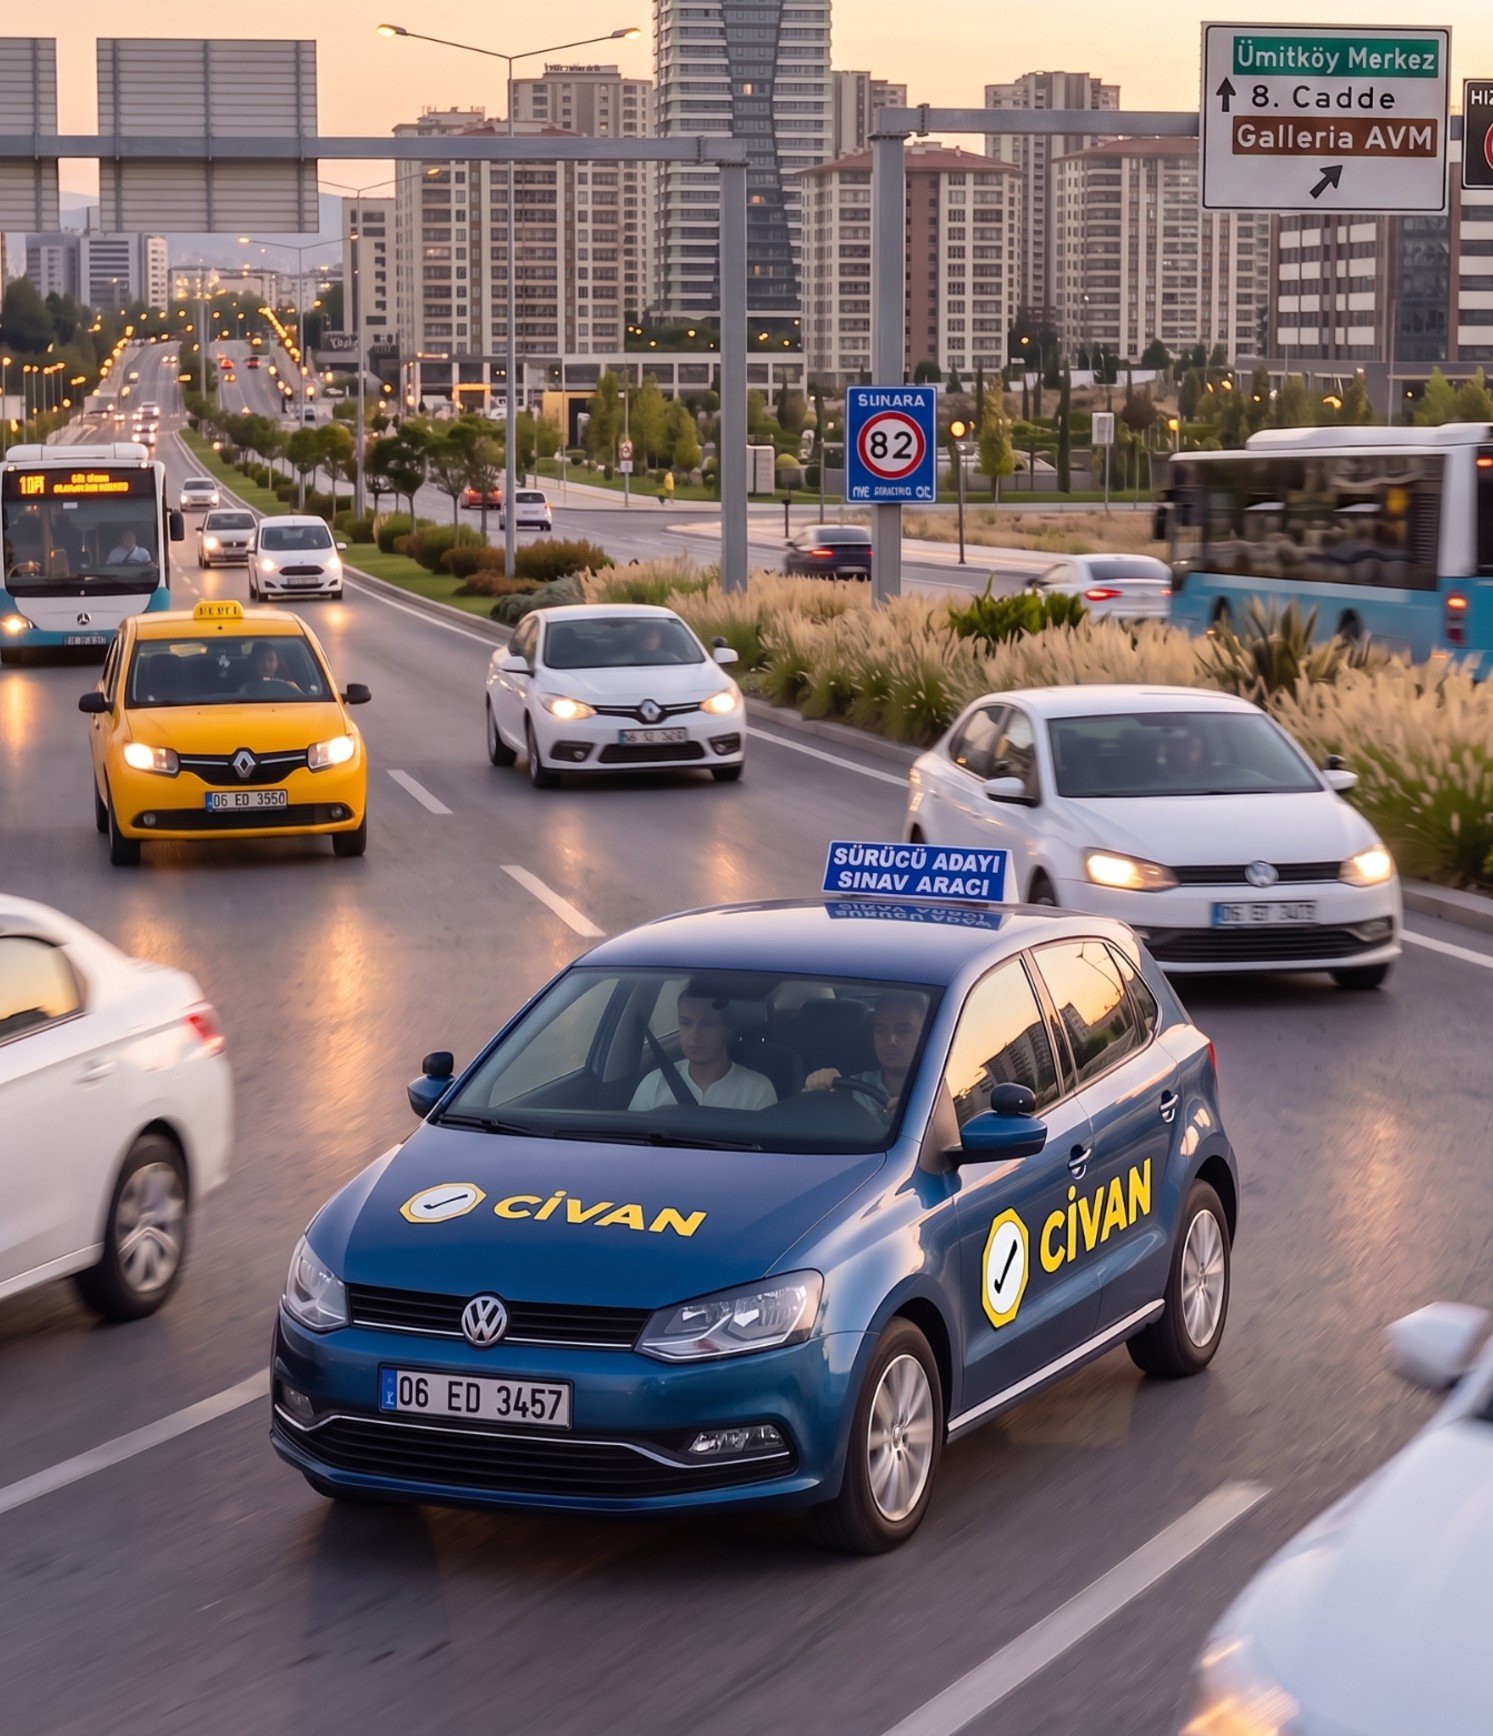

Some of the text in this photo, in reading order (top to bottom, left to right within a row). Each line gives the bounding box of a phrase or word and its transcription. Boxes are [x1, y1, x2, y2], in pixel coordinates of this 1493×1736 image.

[1237, 39, 1435, 74] Ümitköy Merkez
[1251, 84, 1396, 109] 8. Cadde
[1236, 123, 1432, 150] Galleria AVM
[870, 430, 912, 459] 82
[213, 794, 228, 807] 06
[257, 792, 286, 805] 3550
[833, 844, 1001, 874] SÜRÜCÜ ADAYI
[837, 871, 990, 896] SINAV ARACI
[493, 1190, 707, 1237] CİVAN
[1040, 1157, 1151, 1273] CİVAN
[399, 1375, 430, 1408] 06
[447, 1380, 481, 1414] ED
[496, 1385, 563, 1421] 3457
